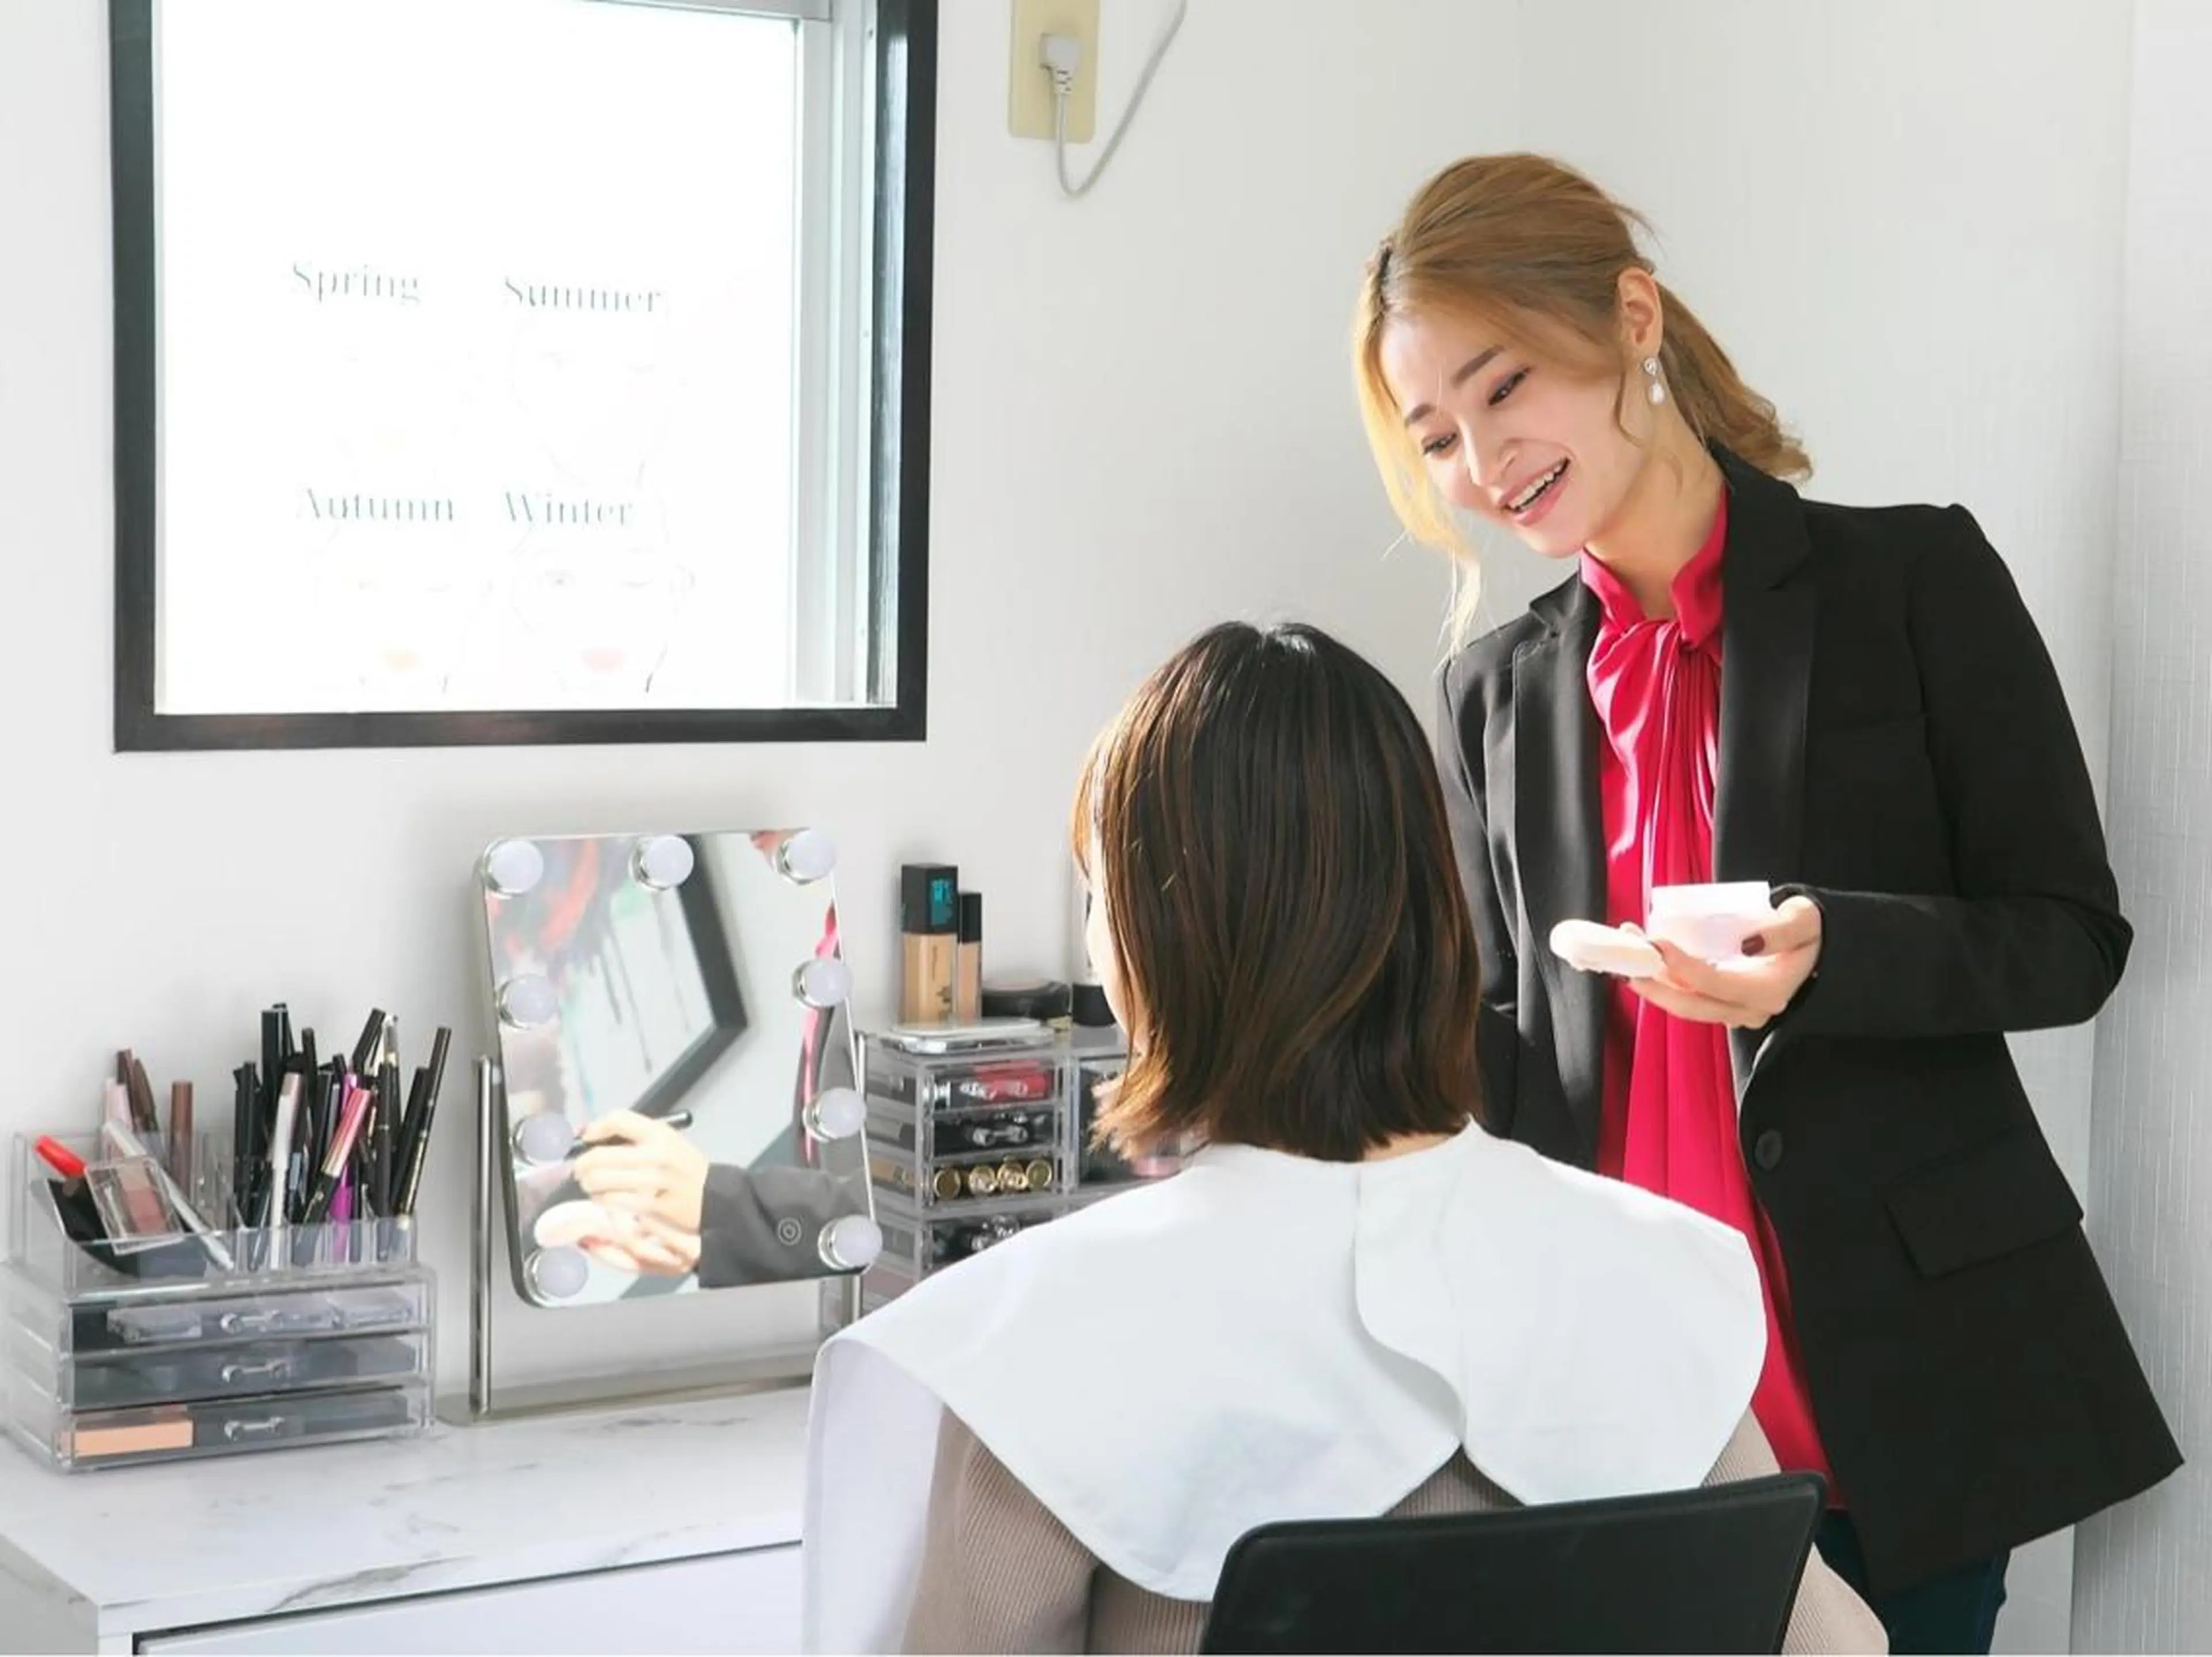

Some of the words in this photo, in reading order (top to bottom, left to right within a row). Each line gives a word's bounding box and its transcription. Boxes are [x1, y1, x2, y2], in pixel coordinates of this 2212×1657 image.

[291, 261, 421, 305] Spring
[503, 275, 662, 312] Summer
[300, 487, 454, 522] Autumn
[503, 489, 633, 525] Winter
